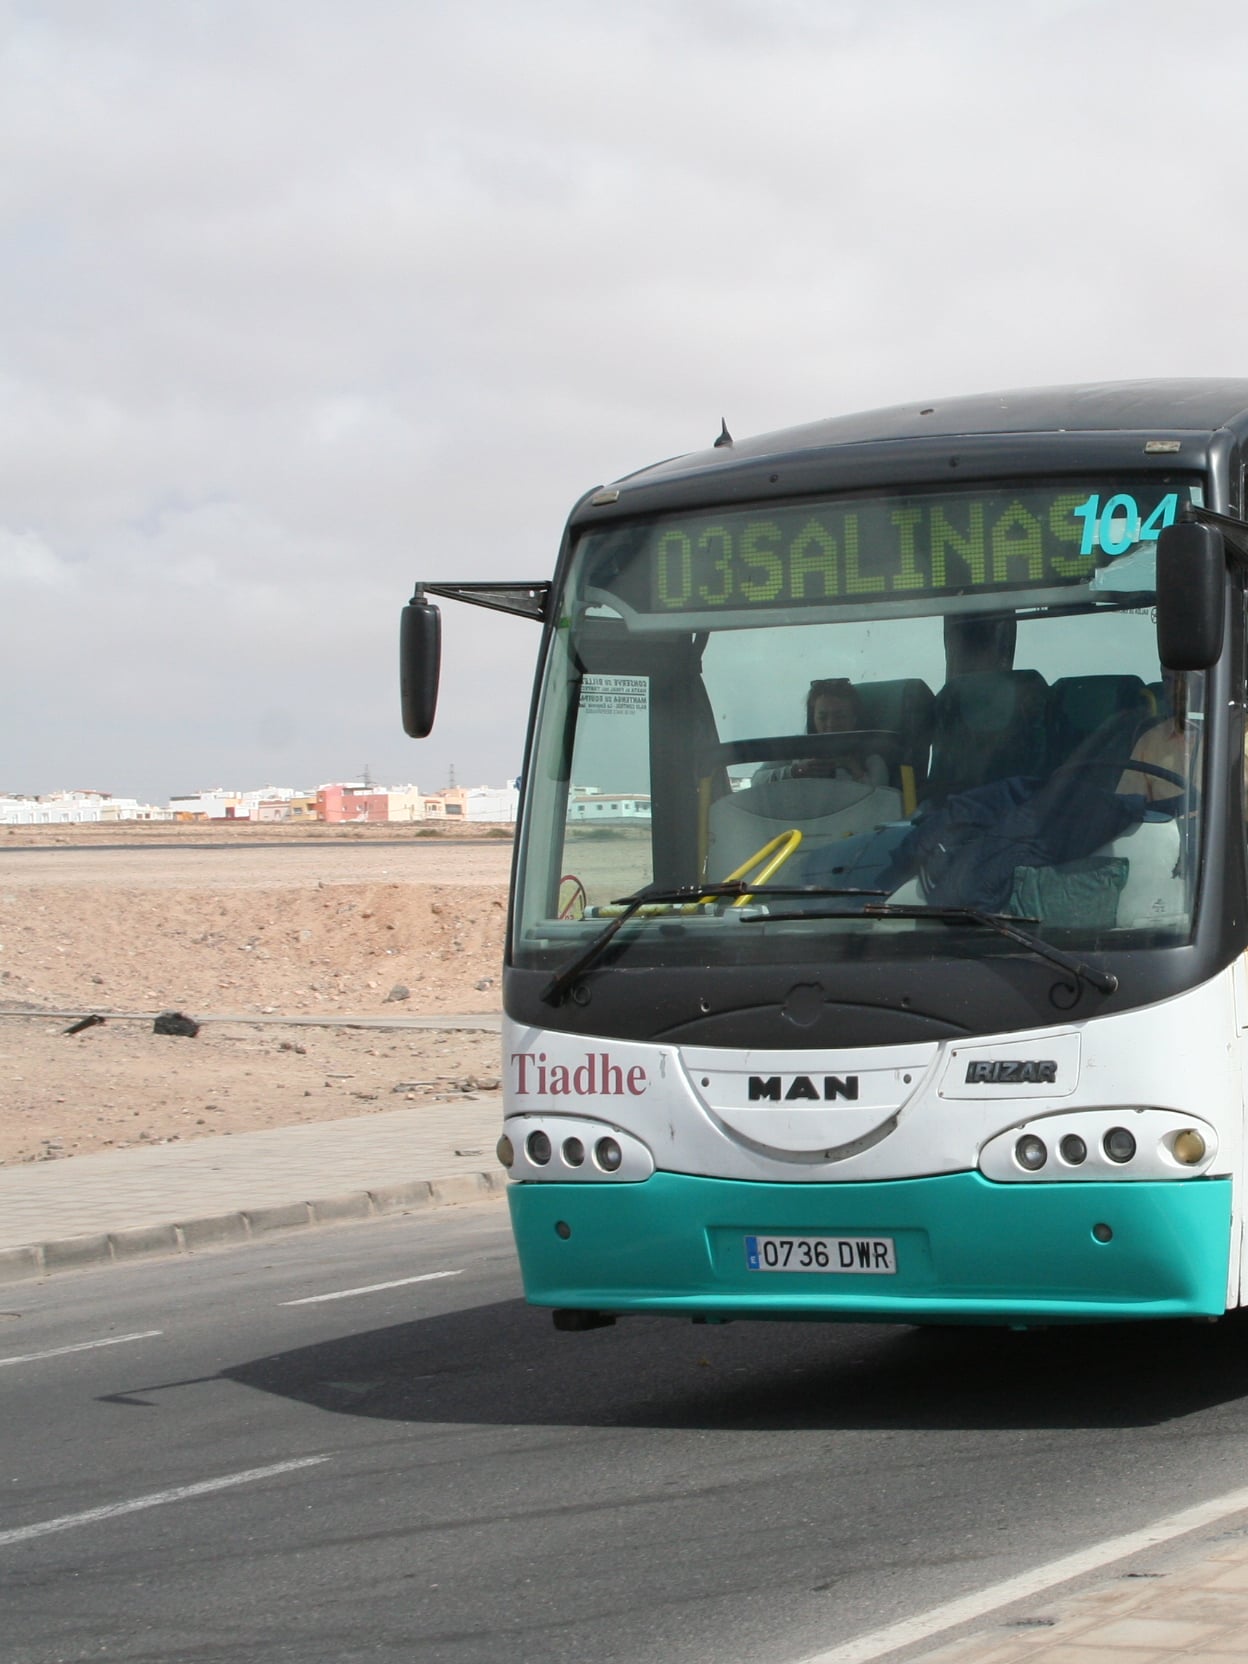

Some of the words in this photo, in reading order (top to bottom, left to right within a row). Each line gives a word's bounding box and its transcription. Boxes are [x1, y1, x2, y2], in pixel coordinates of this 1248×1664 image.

[1073, 493, 1178, 556] 104
[511, 1052, 647, 1096] Tiadhe
[965, 1060, 1058, 1084] IRIZAR
[748, 1075, 859, 1101] MAN
[763, 1241, 829, 1268] 0736
[838, 1241, 890, 1268] DWR
